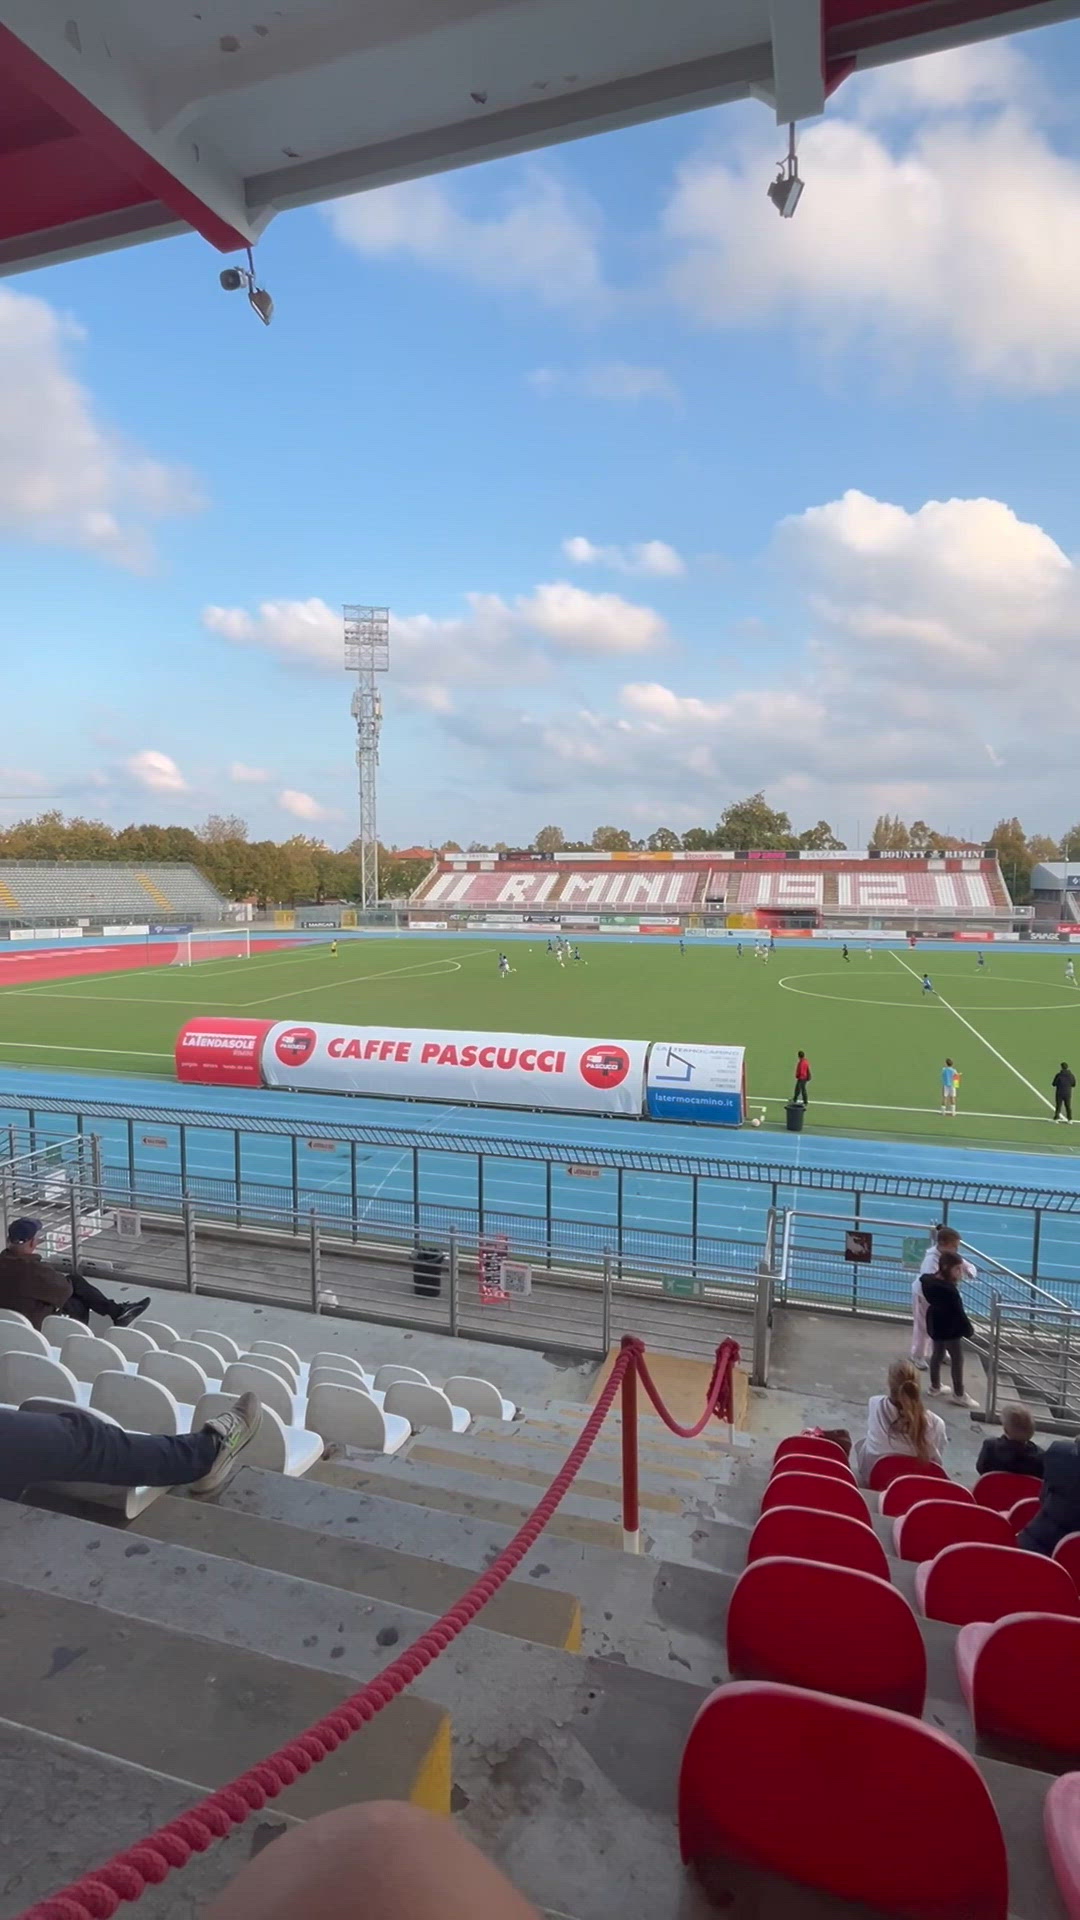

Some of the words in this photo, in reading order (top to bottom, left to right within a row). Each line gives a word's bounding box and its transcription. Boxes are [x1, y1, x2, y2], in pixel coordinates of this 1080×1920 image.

[880, 851, 927, 859] BOUNTY
[944, 851, 985, 859] RIMINI
[497, 874, 684, 903] RIMINI
[1030, 932, 1060, 940] SAVAGE
[327, 1037, 412, 1063] CAFFE
[420, 1042, 566, 1074] PASCUCCI
[655, 1092, 734, 1107] latermocamino.it
